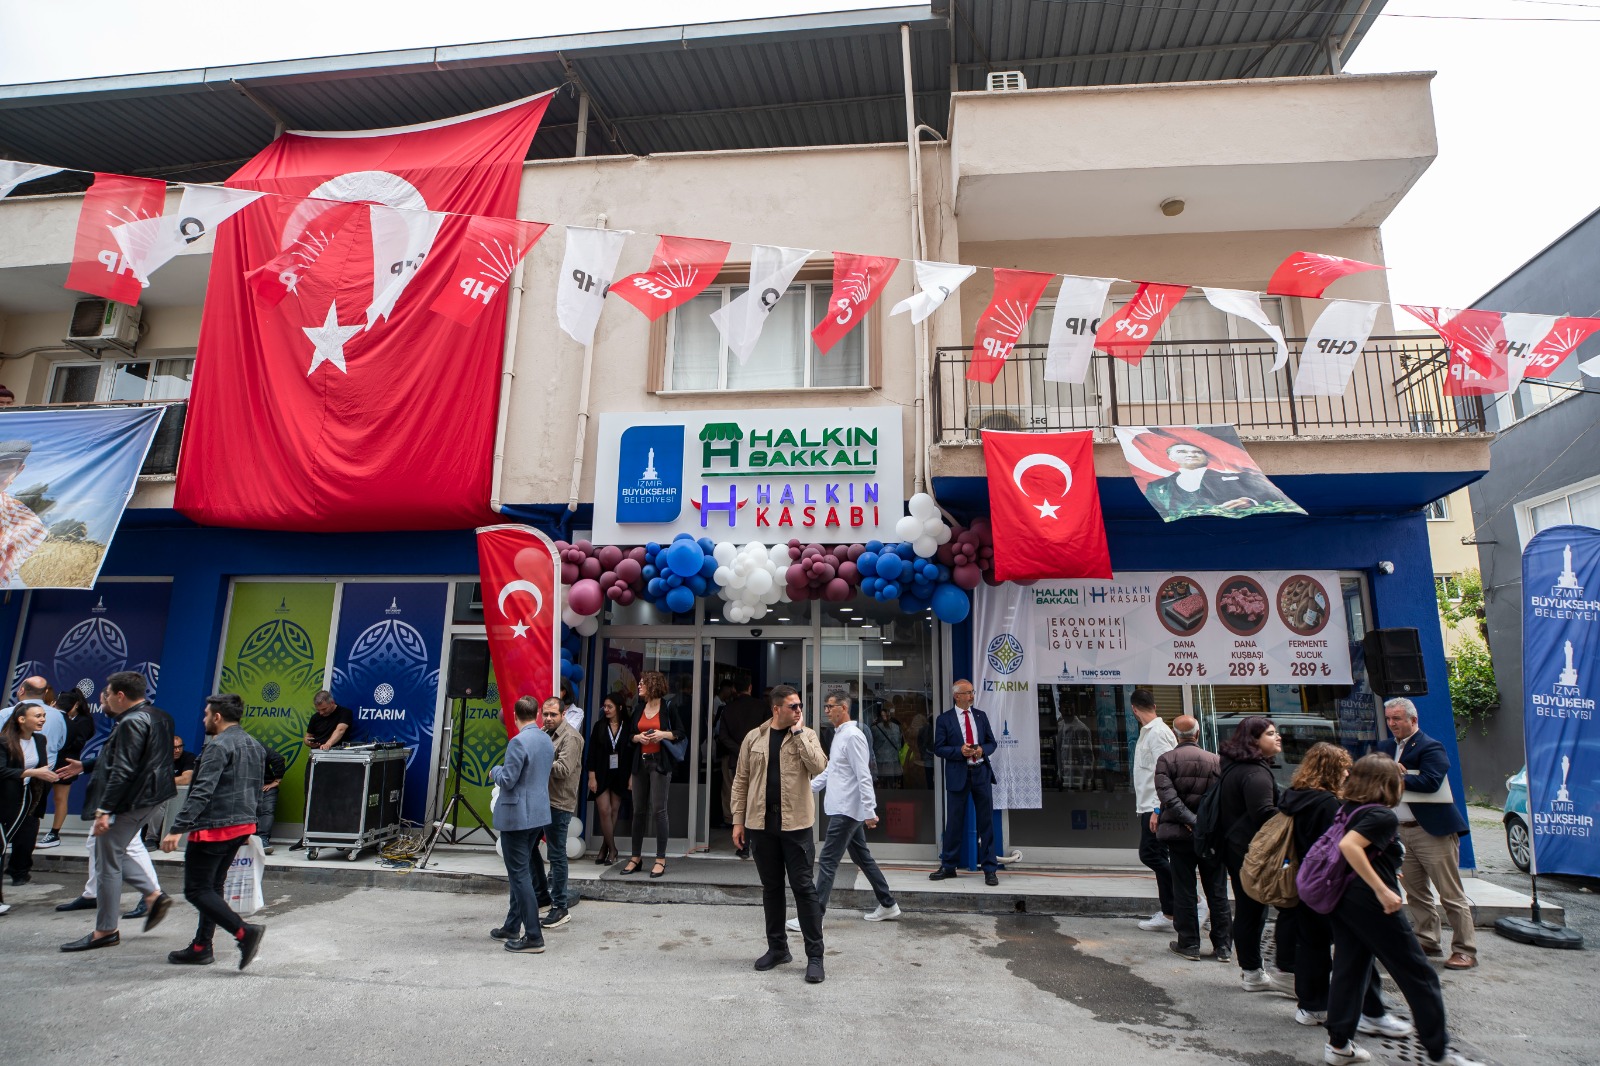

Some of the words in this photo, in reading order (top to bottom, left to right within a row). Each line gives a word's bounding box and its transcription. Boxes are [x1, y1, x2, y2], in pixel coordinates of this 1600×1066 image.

[750, 426, 878, 448] HALKIN
[748, 449, 878, 467] BAKKALI
[756, 482, 879, 505] HALKIN
[756, 506, 879, 527] KASABI
[1036, 588, 1079, 597] HALKIN
[1109, 586, 1151, 595] HALKIN
[1036, 597, 1079, 605] BAKKALI
[1110, 594, 1152, 603] KASABI
[1051, 615, 1121, 626] EKONOMİK
[1052, 627, 1122, 638] SAĞLIKLI
[1052, 638, 1123, 650] GÜVENLİ
[1173, 640, 1196, 648] DANA
[1234, 640, 1258, 648] DANA
[1288, 640, 1328, 648] FERMENTE
[1174, 651, 1199, 660] KIYMA
[1231, 651, 1264, 660] KUŞBAŞI
[1295, 651, 1323, 659] SUCUK
[1167, 662, 1194, 677] 269
[1228, 662, 1256, 677] 289
[1290, 662, 1318, 677] 289
[983, 678, 1029, 692] İZTARIM
[245, 706, 292, 718] İZTARIM
[358, 706, 406, 721] İZTARIM
[466, 706, 500, 720] İZTAR
